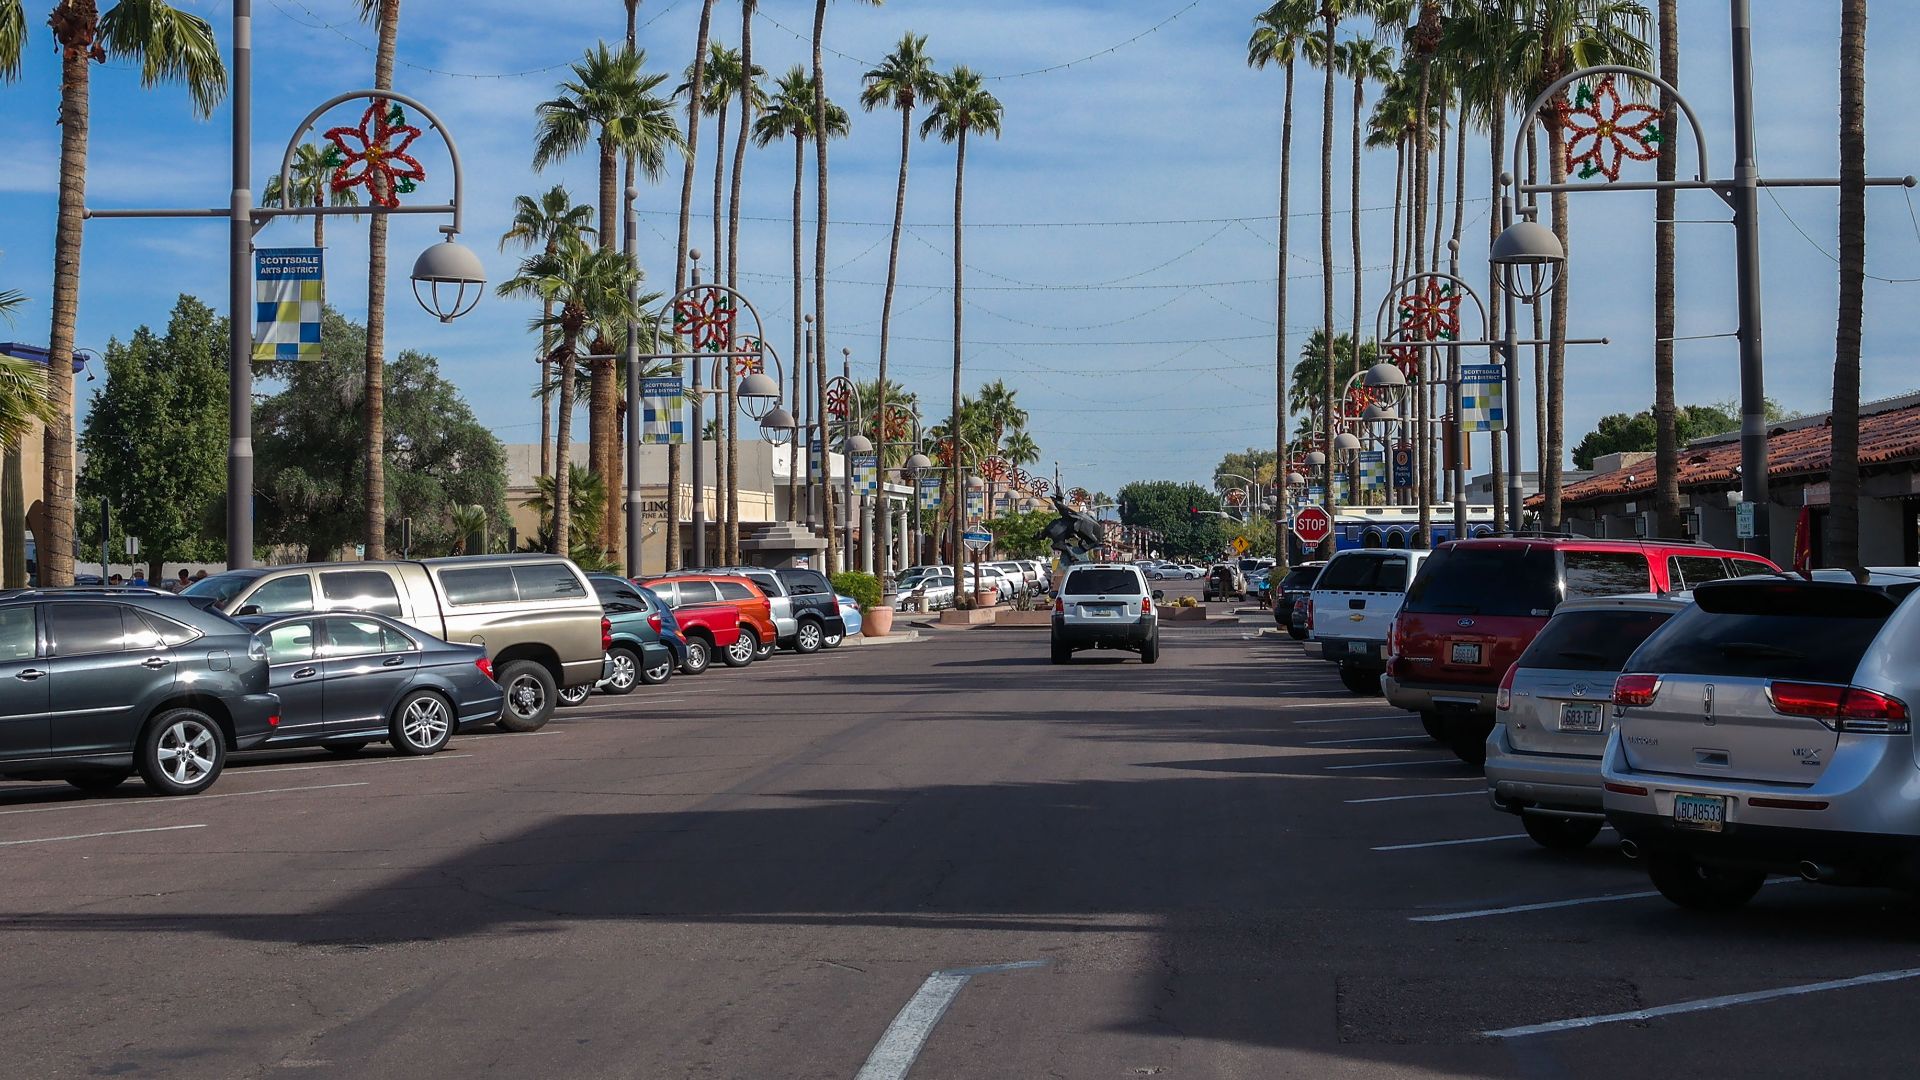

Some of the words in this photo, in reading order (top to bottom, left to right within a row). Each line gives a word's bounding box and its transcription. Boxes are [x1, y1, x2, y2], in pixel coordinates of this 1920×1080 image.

[260, 256, 319, 264] SCOTTSDALE
[260, 266, 281, 274] ARTS
[282, 266, 319, 274] DISTRICT
[1297, 518, 1326, 531] STOP
[1681, 802, 1721, 822] BCA8533
